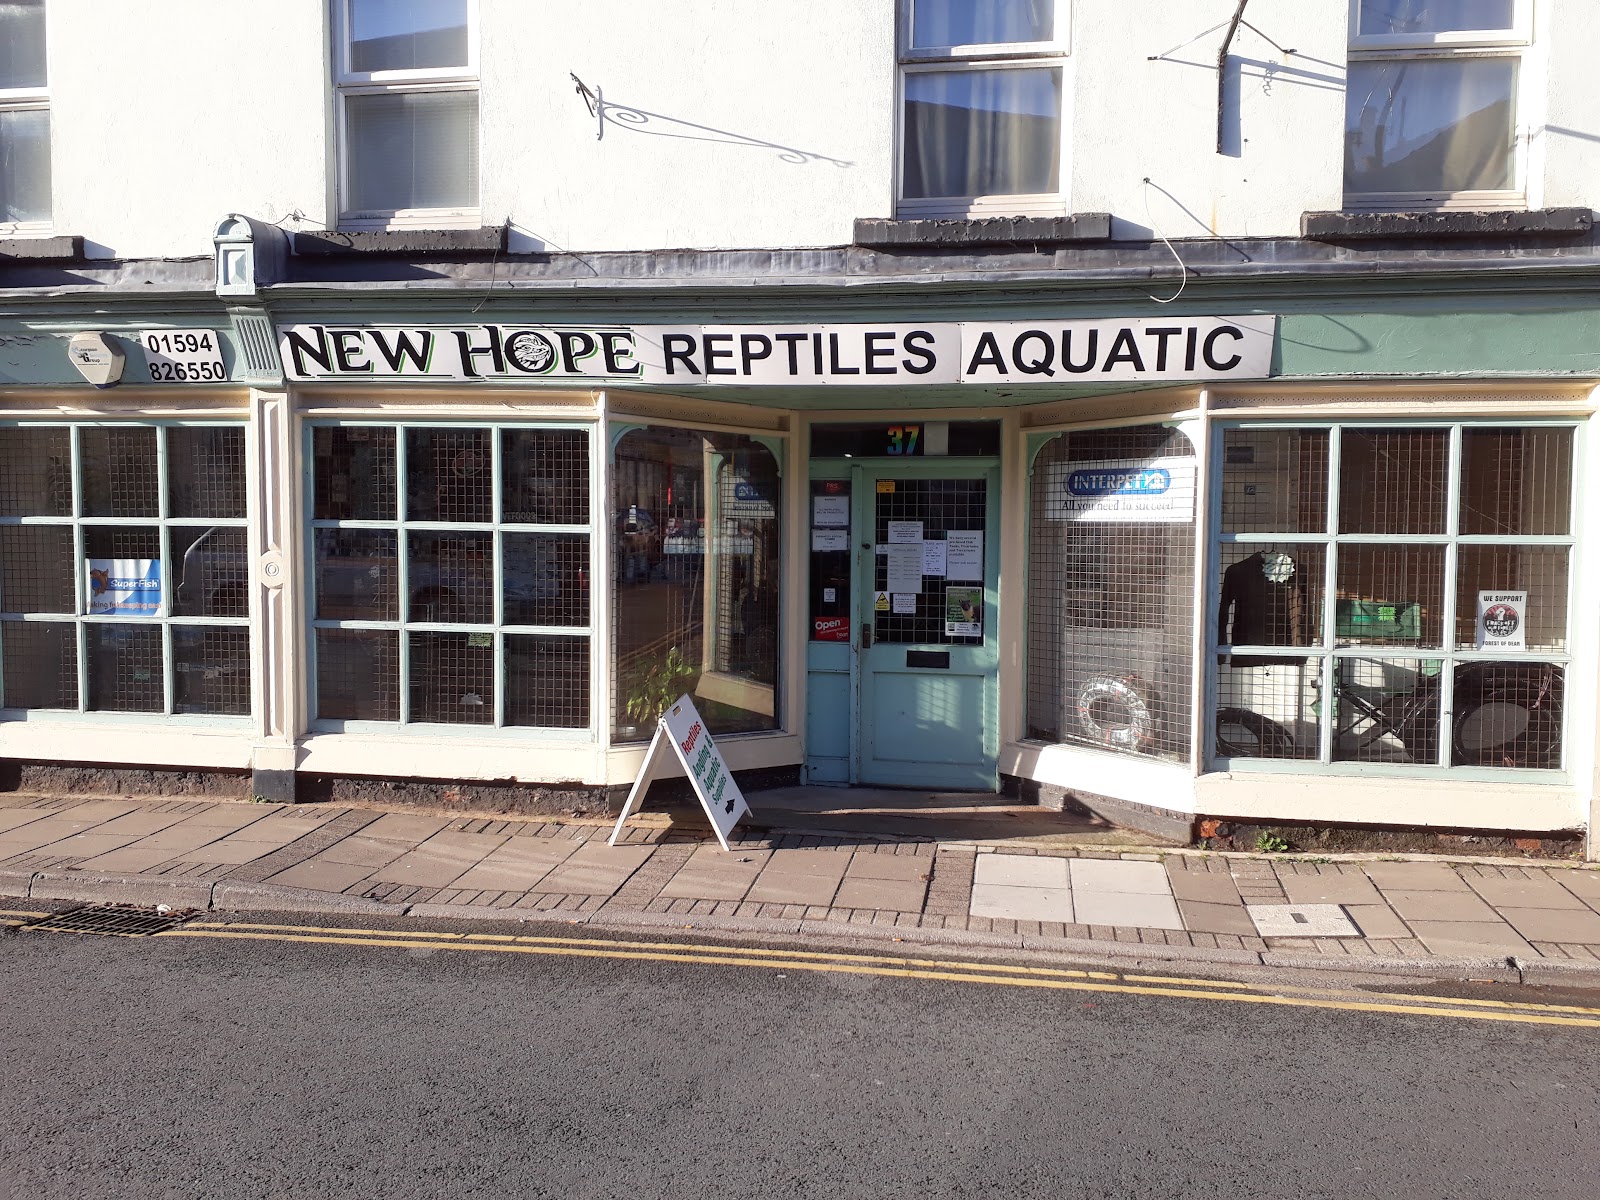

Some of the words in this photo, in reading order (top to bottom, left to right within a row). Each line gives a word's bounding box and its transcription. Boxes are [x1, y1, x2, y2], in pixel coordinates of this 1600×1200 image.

[147, 333, 213, 353] 01594
[282, 326, 433, 377] NEW
[451, 325, 643, 377] HOPE
[662, 331, 937, 376] REPTILES
[966, 325, 1244, 377] AQUATIC
[149, 361, 226, 381] 826550
[887, 425, 920, 455] 37
[1074, 473, 1142, 490] INTERPET
[1062, 500, 1075, 511] All
[1077, 502, 1094, 514] you
[1096, 500, 1119, 511] need
[1135, 500, 1174, 511] succeed
[110, 579, 158, 589] SuperFish
[815, 619, 841, 631] Open
[681, 721, 702, 756] Reptiles
[692, 744, 711, 780] Angling
[704, 734, 714, 748] &
[703, 756, 721, 794] Aquatic
[712, 773, 727, 806] Supplies
